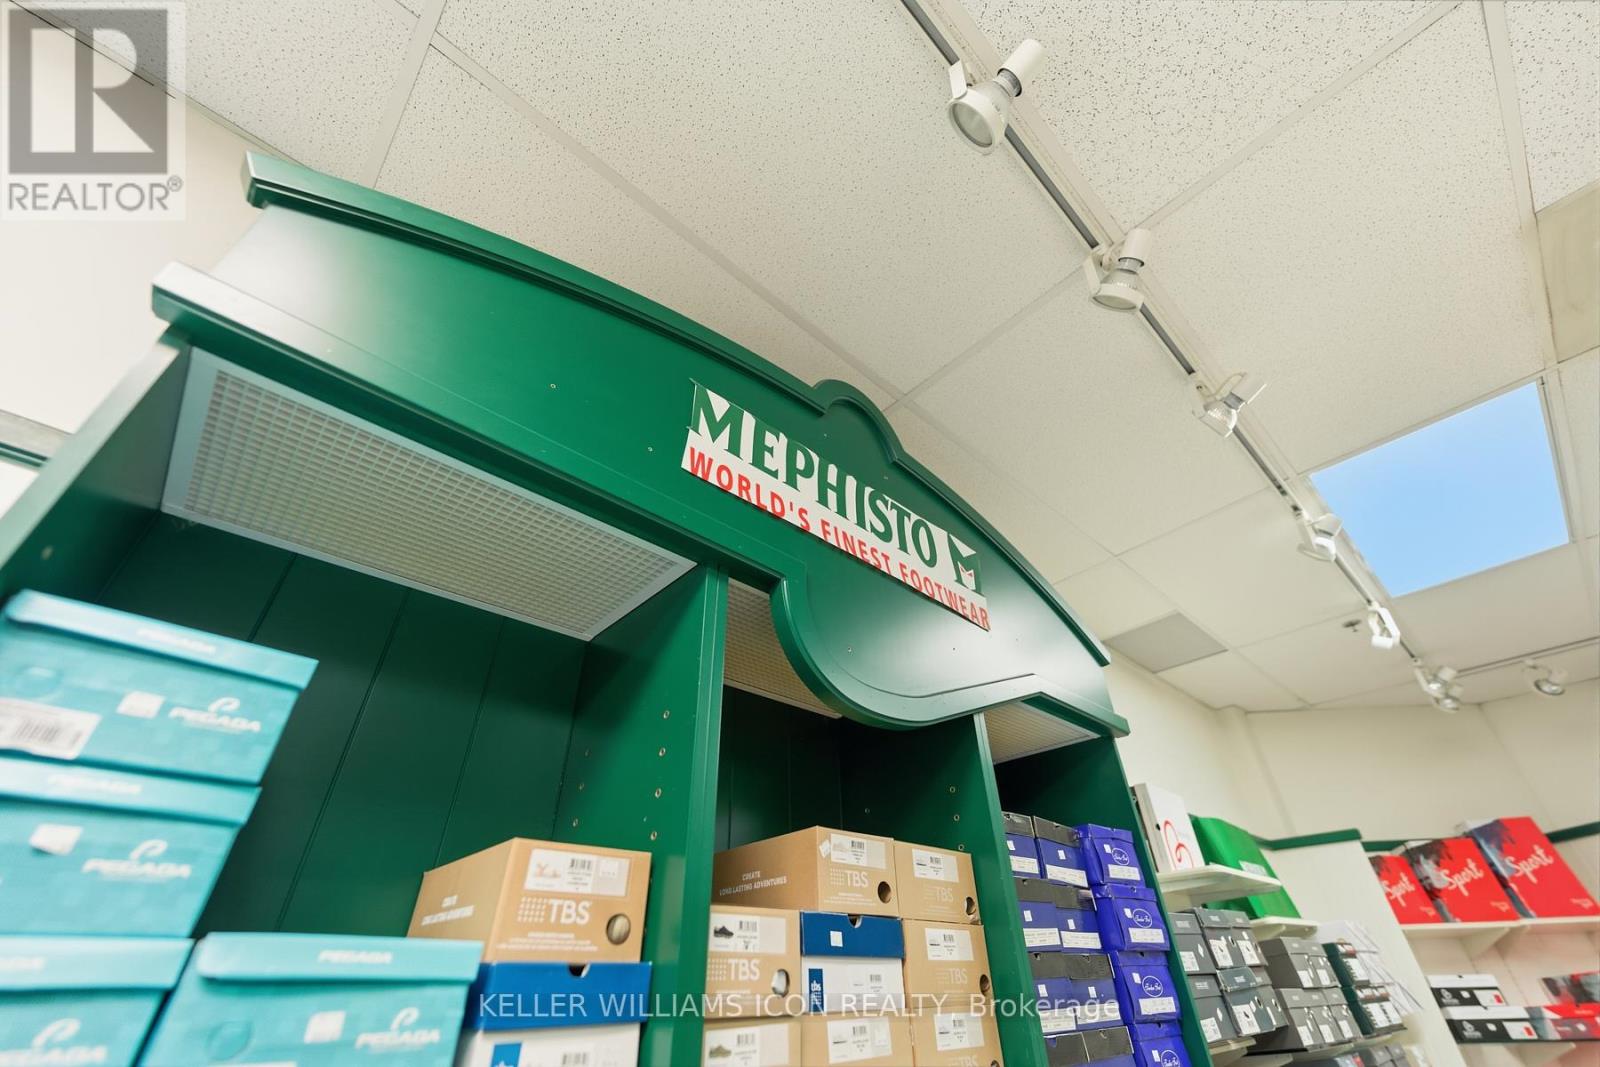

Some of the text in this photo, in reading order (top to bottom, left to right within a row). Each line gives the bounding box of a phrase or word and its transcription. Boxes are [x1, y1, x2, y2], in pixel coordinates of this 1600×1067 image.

[687, 381, 938, 568] MEPHISTO
[689, 447, 990, 631] WORLD'S FINEST FOOTWEAR
[845, 871, 869, 888] TBS
[1440, 858, 1484, 897] Sport
[1505, 845, 1554, 884] Sport
[935, 887, 953, 901] TBS
[1382, 871, 1415, 907] Sport
[549, 899, 590, 925] TBS
[728, 958, 760, 981] TBS
[950, 968, 968, 984] TBS
